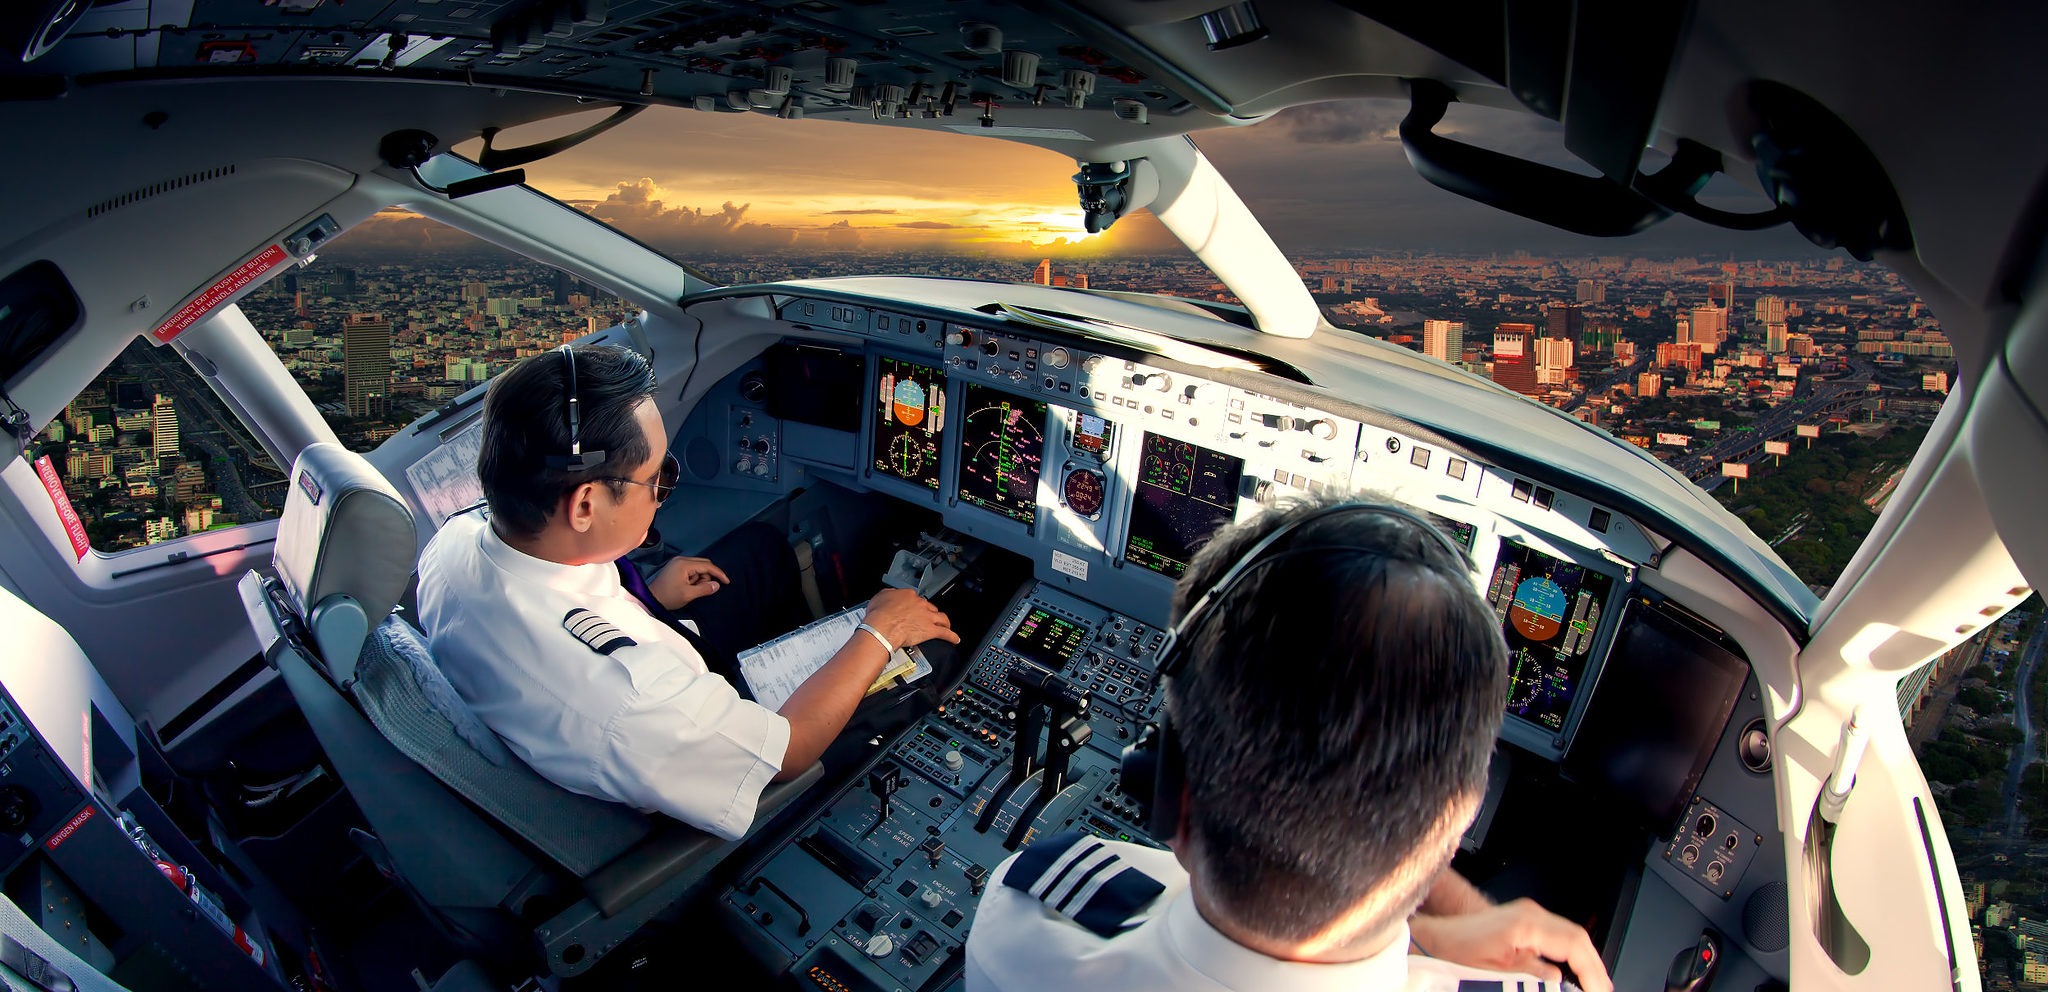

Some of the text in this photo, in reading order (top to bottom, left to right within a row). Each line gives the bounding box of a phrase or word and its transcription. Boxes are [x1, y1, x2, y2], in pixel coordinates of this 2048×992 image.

[158, 302, 196, 334] EMERGENCY
[194, 292, 210, 306] EXIT
[213, 276, 234, 292] PUSH
[233, 266, 249, 280] THE
[175, 261, 272, 331] TURN THE HANDLE AND SLIDE
[41, 464, 89, 551] REMOVE BEFORE FLIGHT
[51, 809, 92, 846] OXYGEN MASK
[898, 829, 916, 843] SPEED
[892, 834, 911, 848] BRAKE
[932, 880, 957, 897] ENG START
[847, 934, 863, 947] STAB
[899, 957, 913, 968] TRIM
